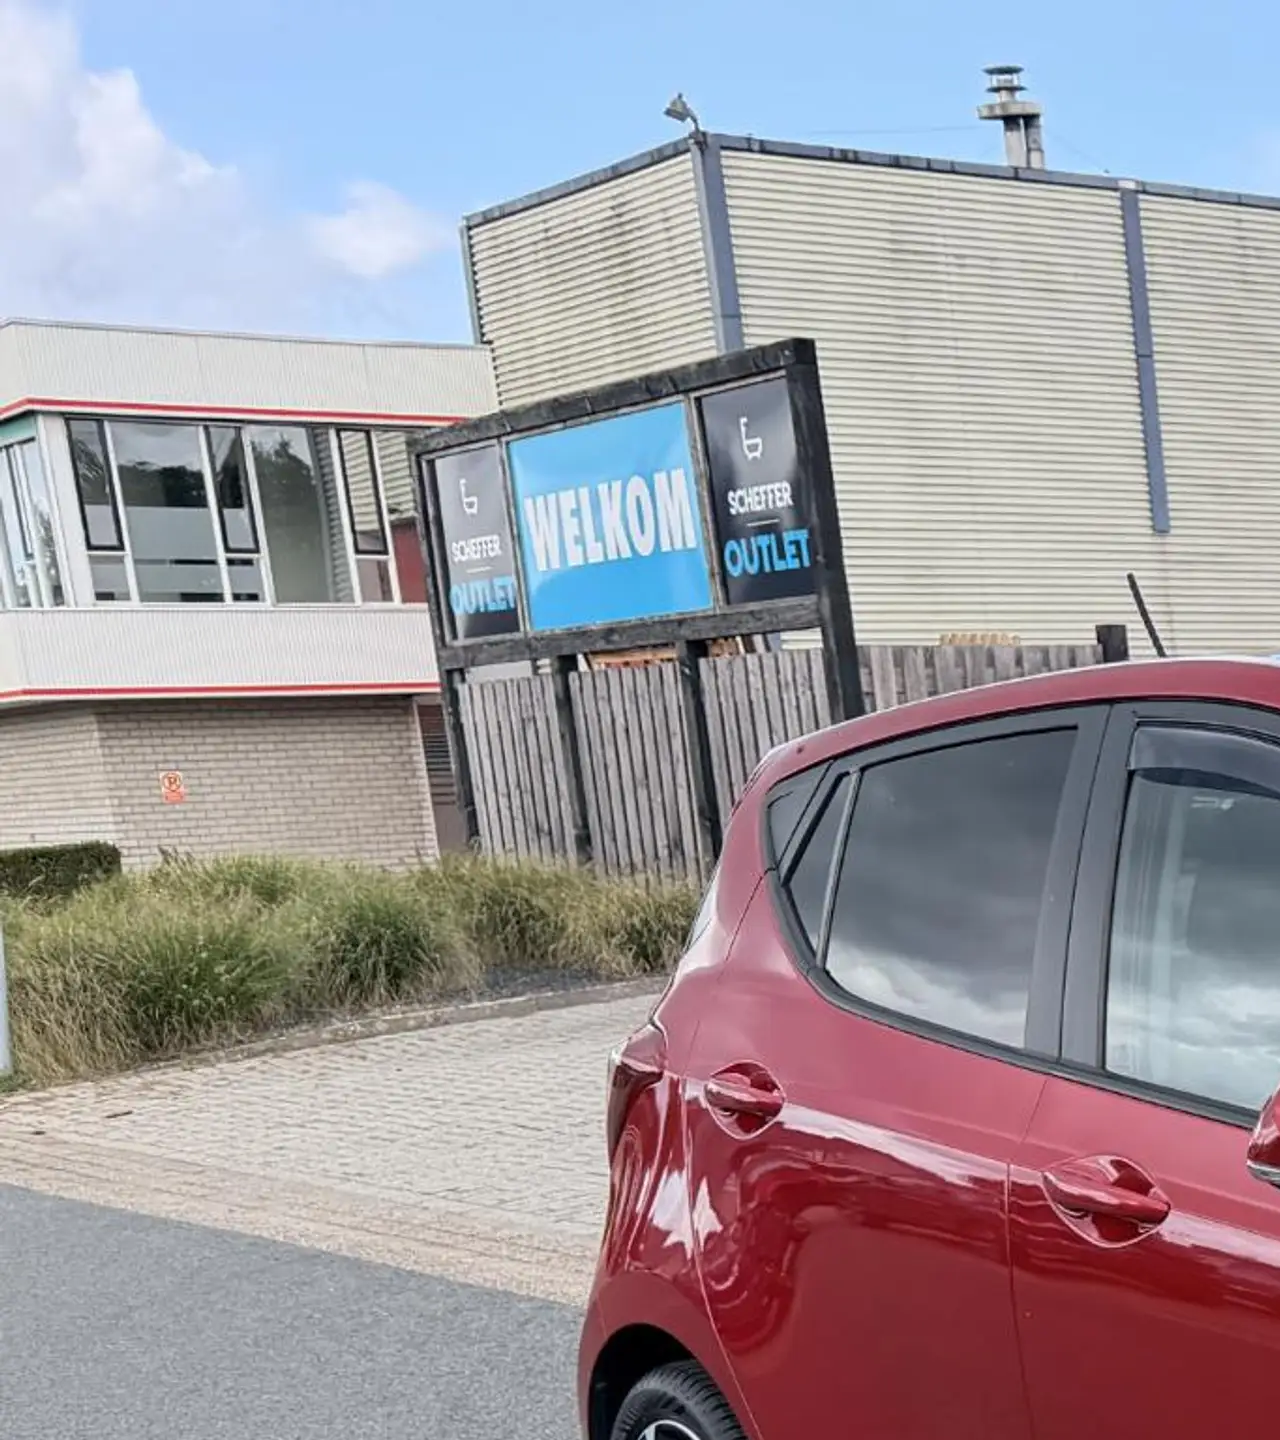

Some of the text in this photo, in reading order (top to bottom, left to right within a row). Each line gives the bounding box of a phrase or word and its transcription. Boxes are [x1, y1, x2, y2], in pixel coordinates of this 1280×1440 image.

[727, 480, 795, 515] SCHEFFER
[524, 468, 697, 572] WELKOM
[724, 528, 811, 577] OUTLET
[450, 576, 515, 615] OUTLET
